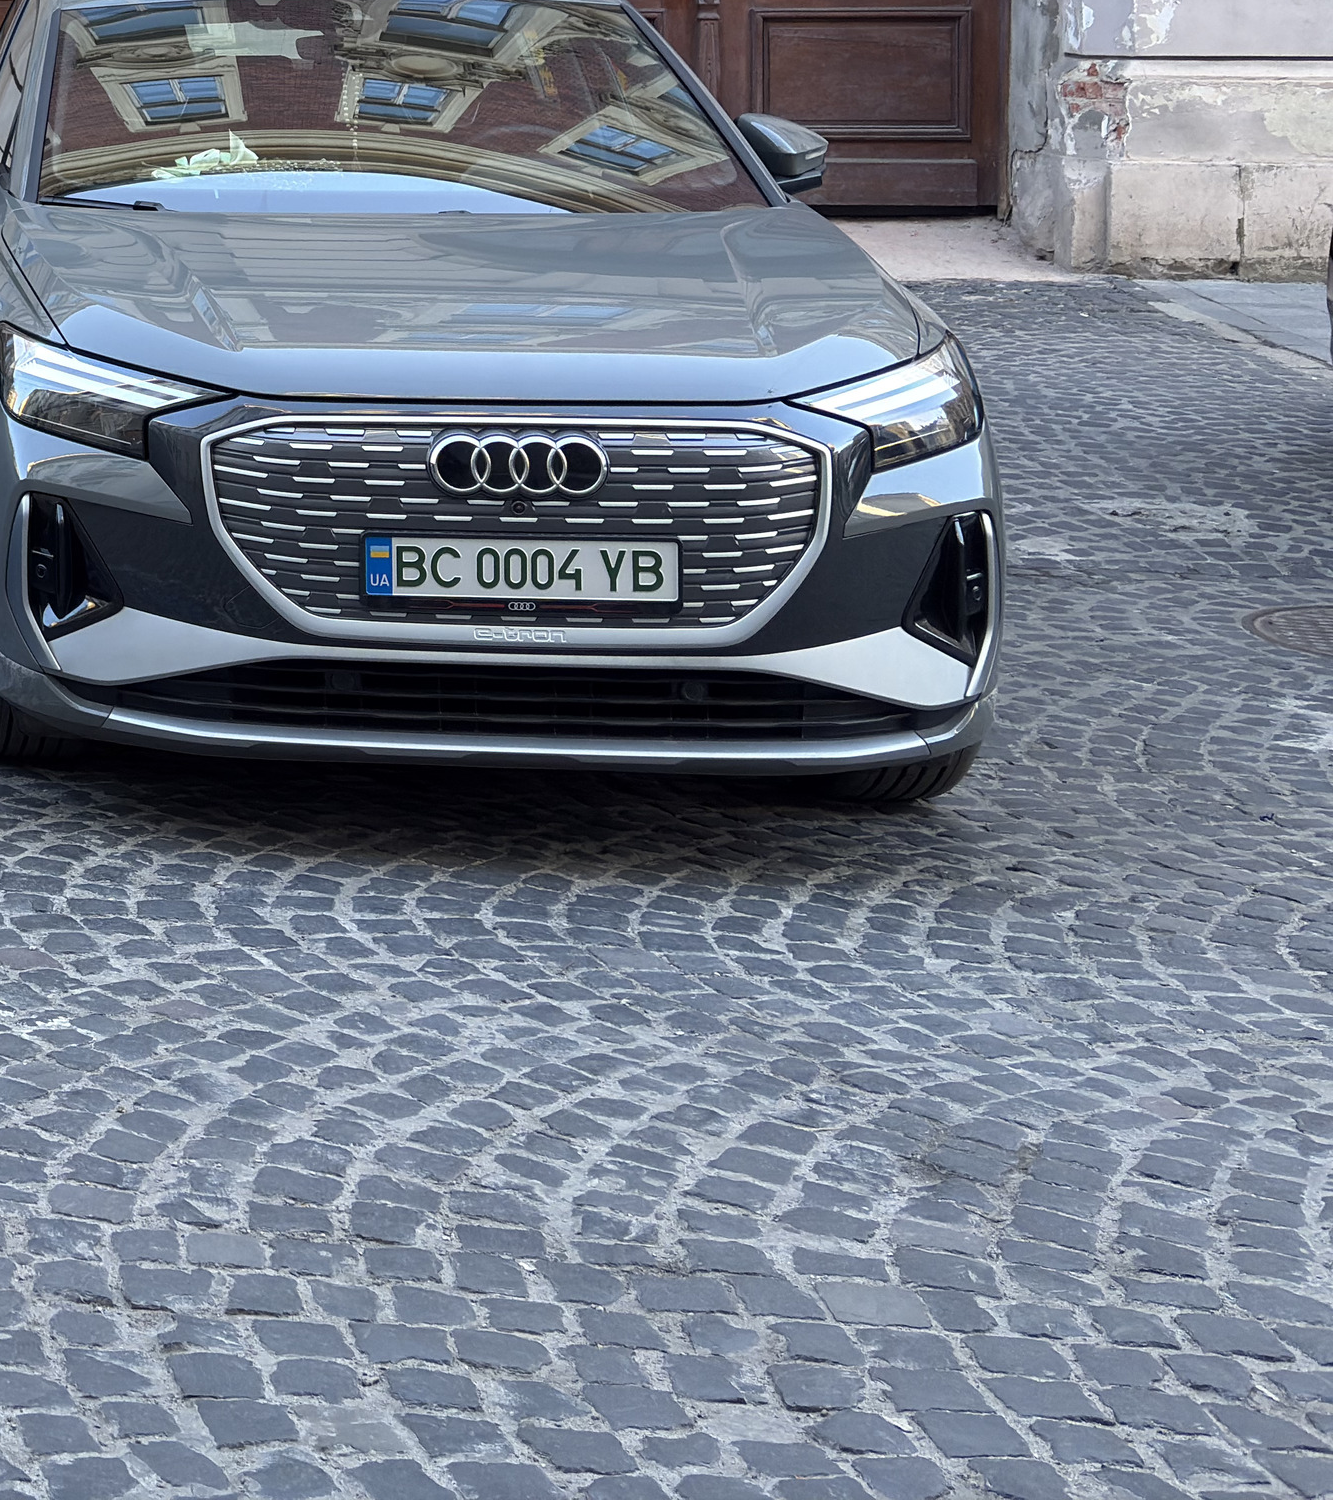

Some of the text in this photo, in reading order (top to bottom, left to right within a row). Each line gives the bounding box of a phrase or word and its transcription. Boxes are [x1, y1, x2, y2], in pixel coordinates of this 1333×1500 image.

[476, 547, 583, 592] 0004
[370, 574, 390, 588] UA
[473, 626, 567, 643] e-tron
